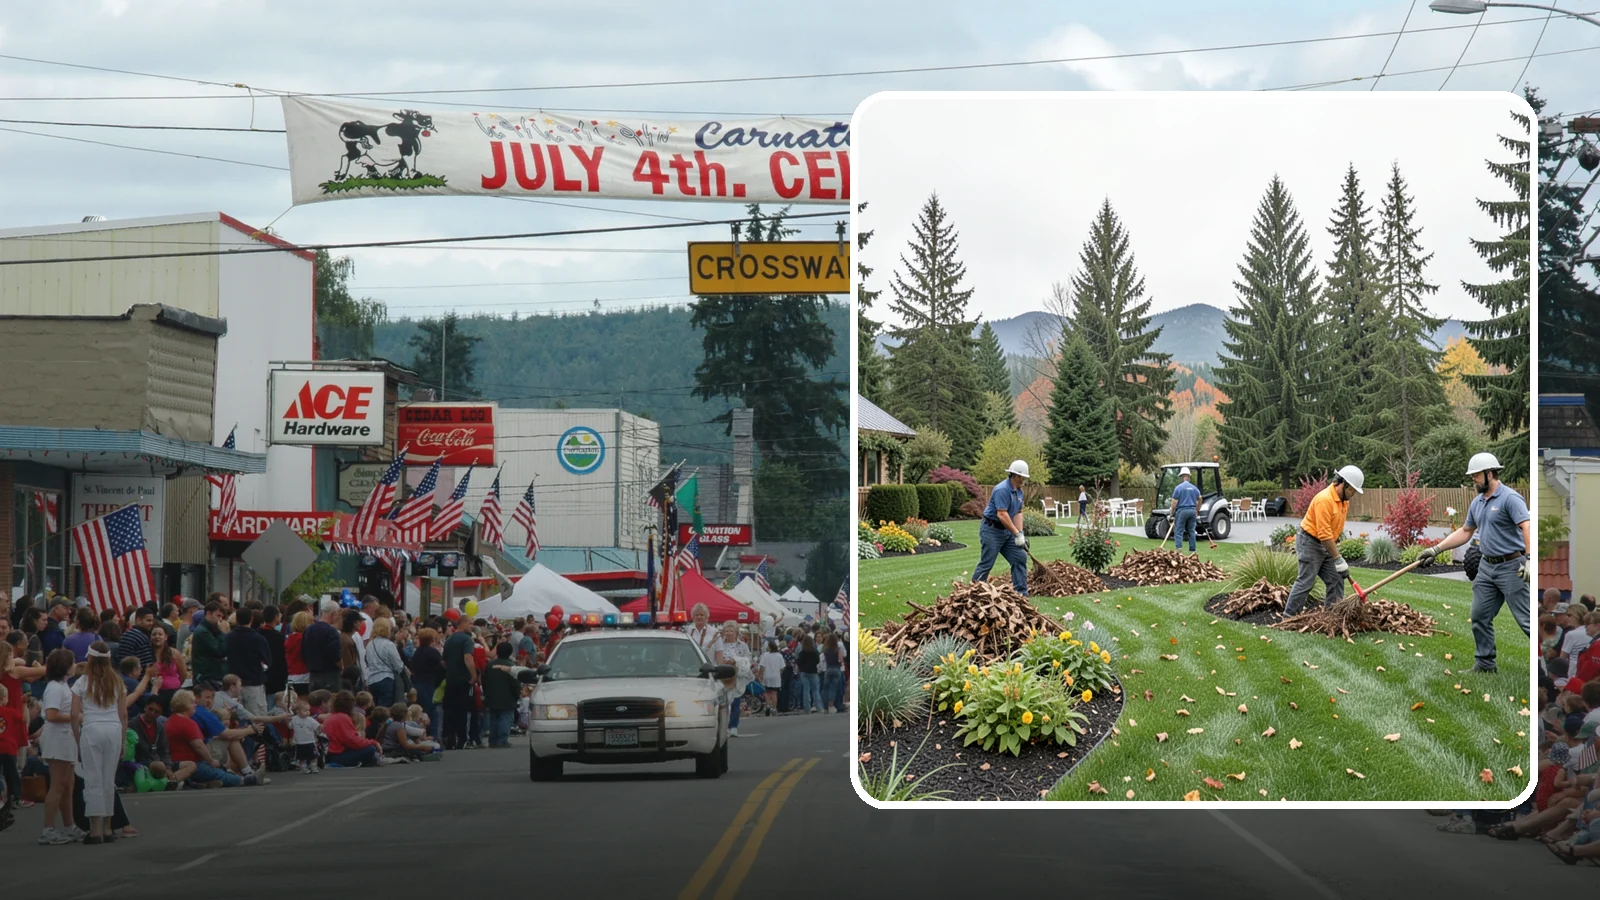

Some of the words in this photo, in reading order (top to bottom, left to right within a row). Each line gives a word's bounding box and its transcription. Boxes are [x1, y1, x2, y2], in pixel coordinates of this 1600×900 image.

[481, 141, 605, 192] JULY
[632, 150, 746, 198] 4th.
[697, 254, 850, 280] CROSSWA
[282, 380, 374, 420] ACE
[406, 409, 453, 422] CEDAR
[283, 421, 371, 437] Hardware
[416, 428, 477, 447] Coca-Cola
[96, 485, 125, 495] Vincent
[126, 486, 136, 495] de
[137, 486, 155, 495] Paul
[688, 526, 741, 535] CRNATION
[699, 535, 730, 543] GLASS
